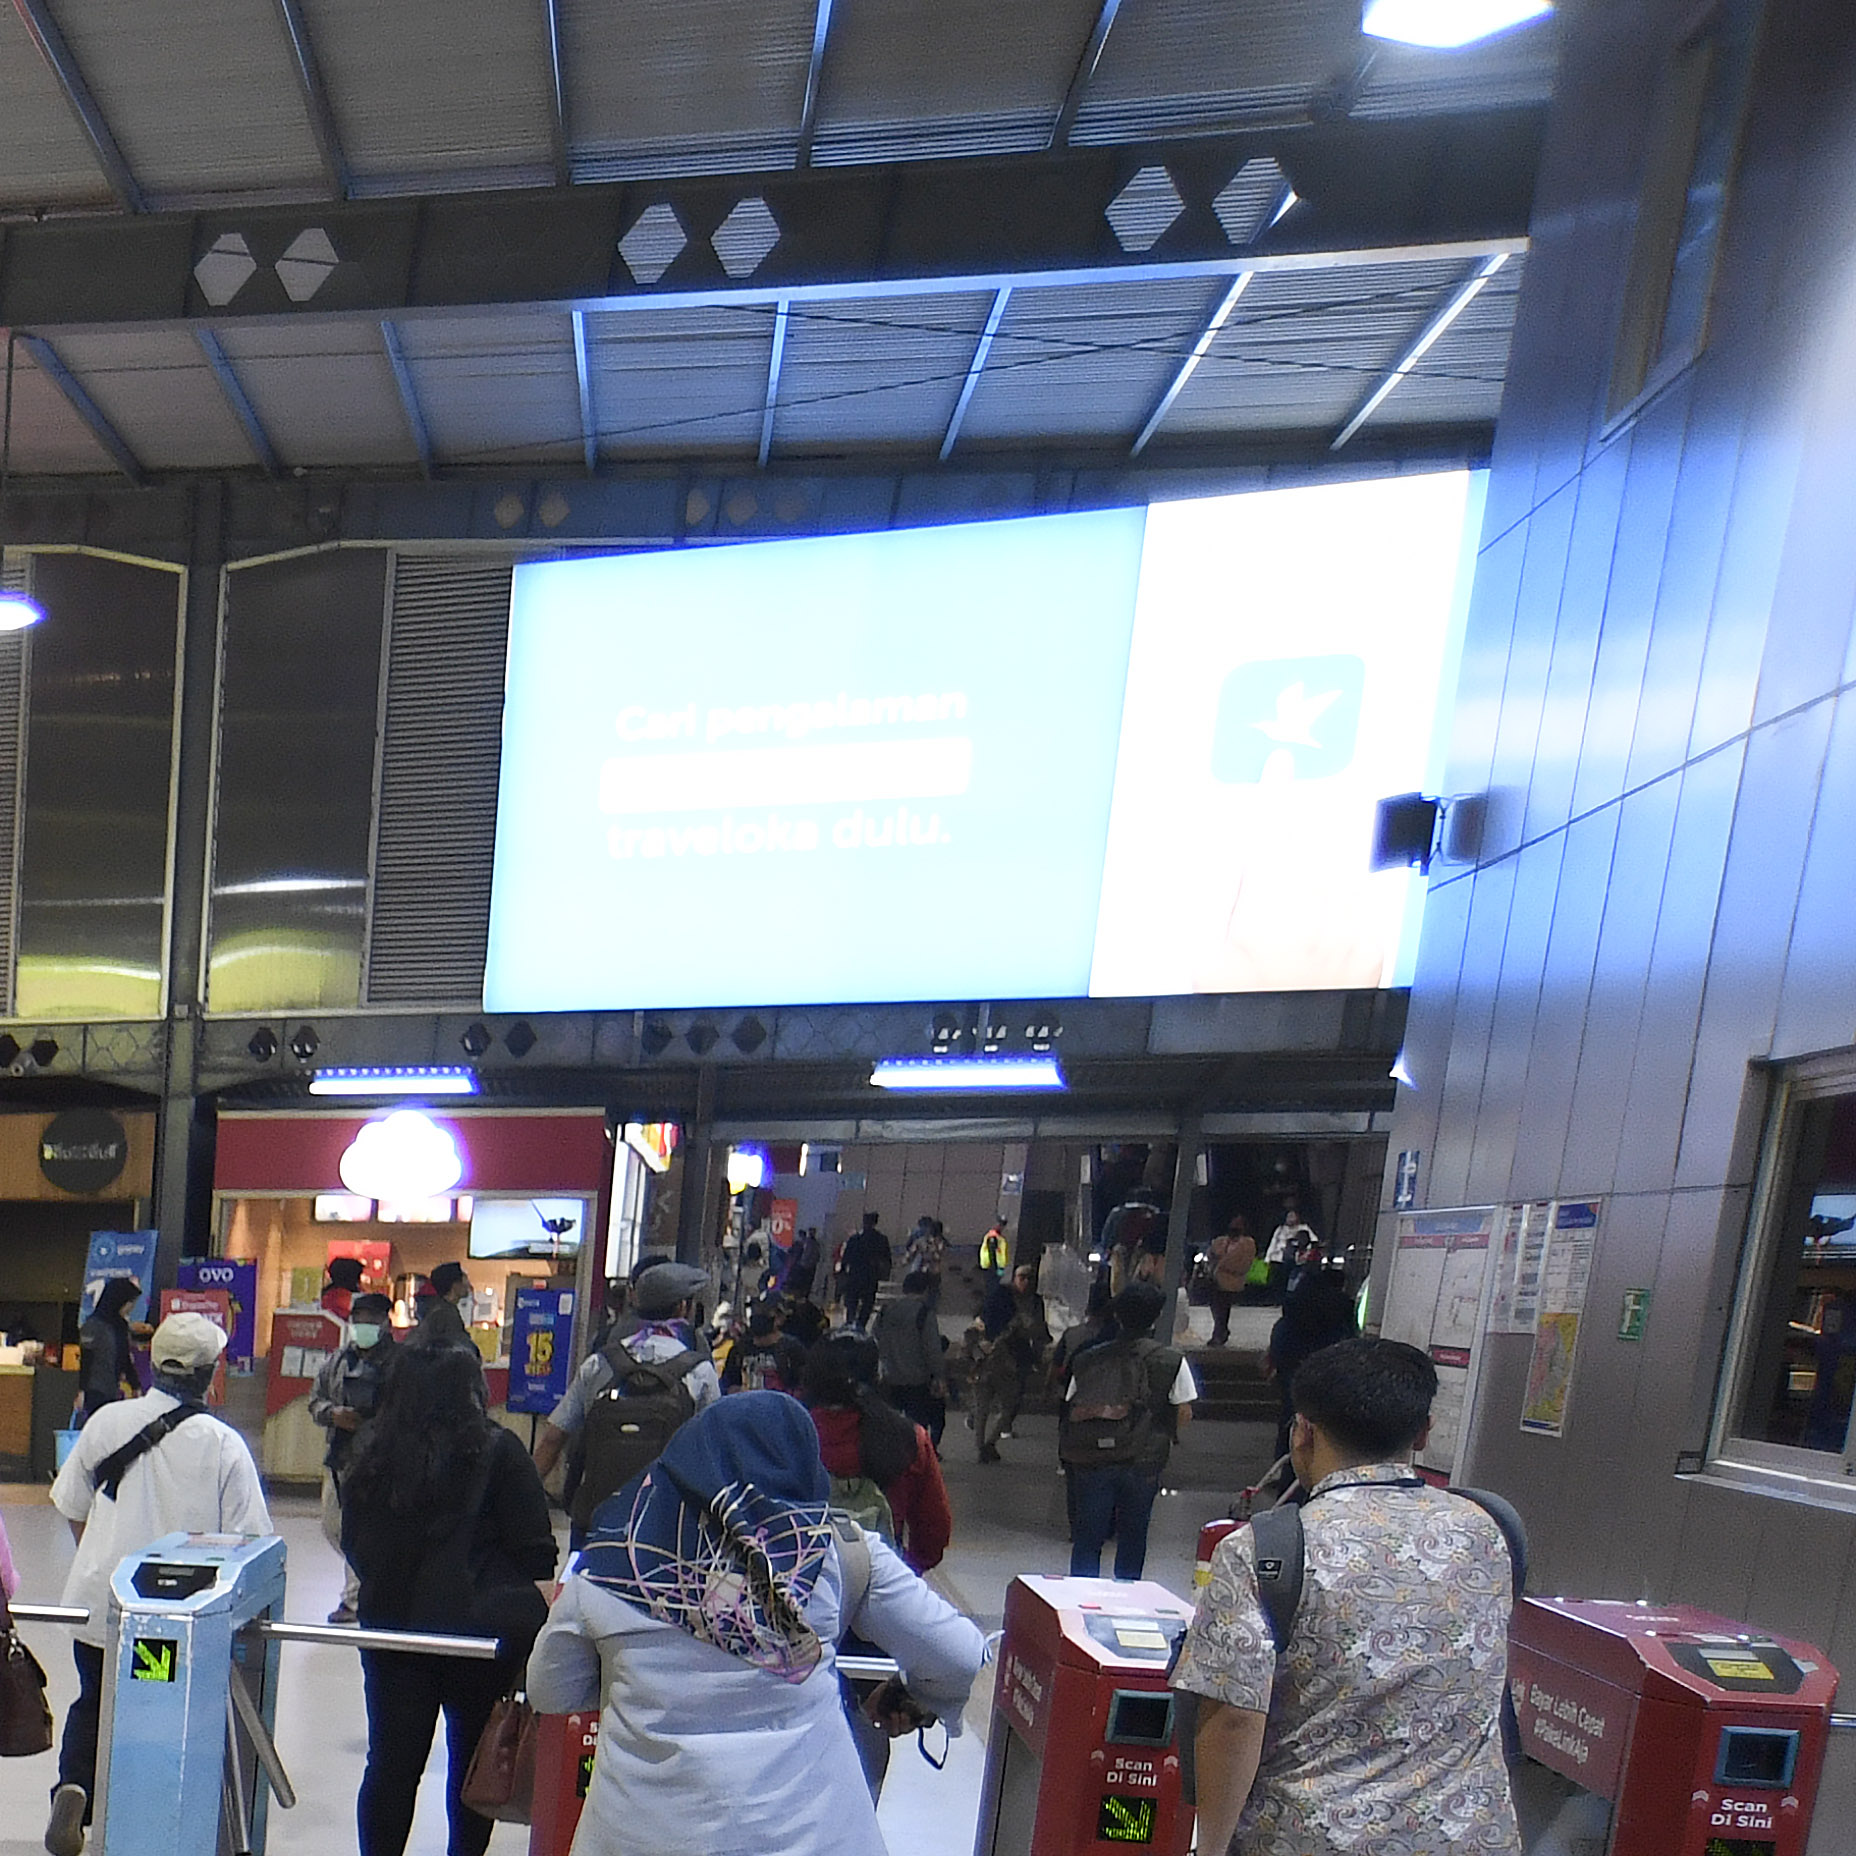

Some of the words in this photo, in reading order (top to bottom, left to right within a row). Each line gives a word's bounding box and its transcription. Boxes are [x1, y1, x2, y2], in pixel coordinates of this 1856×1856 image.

[615, 701, 698, 743] Cari
[705, 689, 968, 744] pengalaman
[606, 810, 820, 860] traveloka
[832, 806, 952, 850] dulu.
[199, 1267, 235, 1283] OVO
[1115, 1757, 1154, 1772] Scan
[1106, 1771, 1123, 1784] Di
[1128, 1773, 1158, 1787] Sini
[1721, 1798, 1768, 1814] Scan
[1711, 1813, 1732, 1827] Di
[1738, 1815, 1773, 1830] Sini
